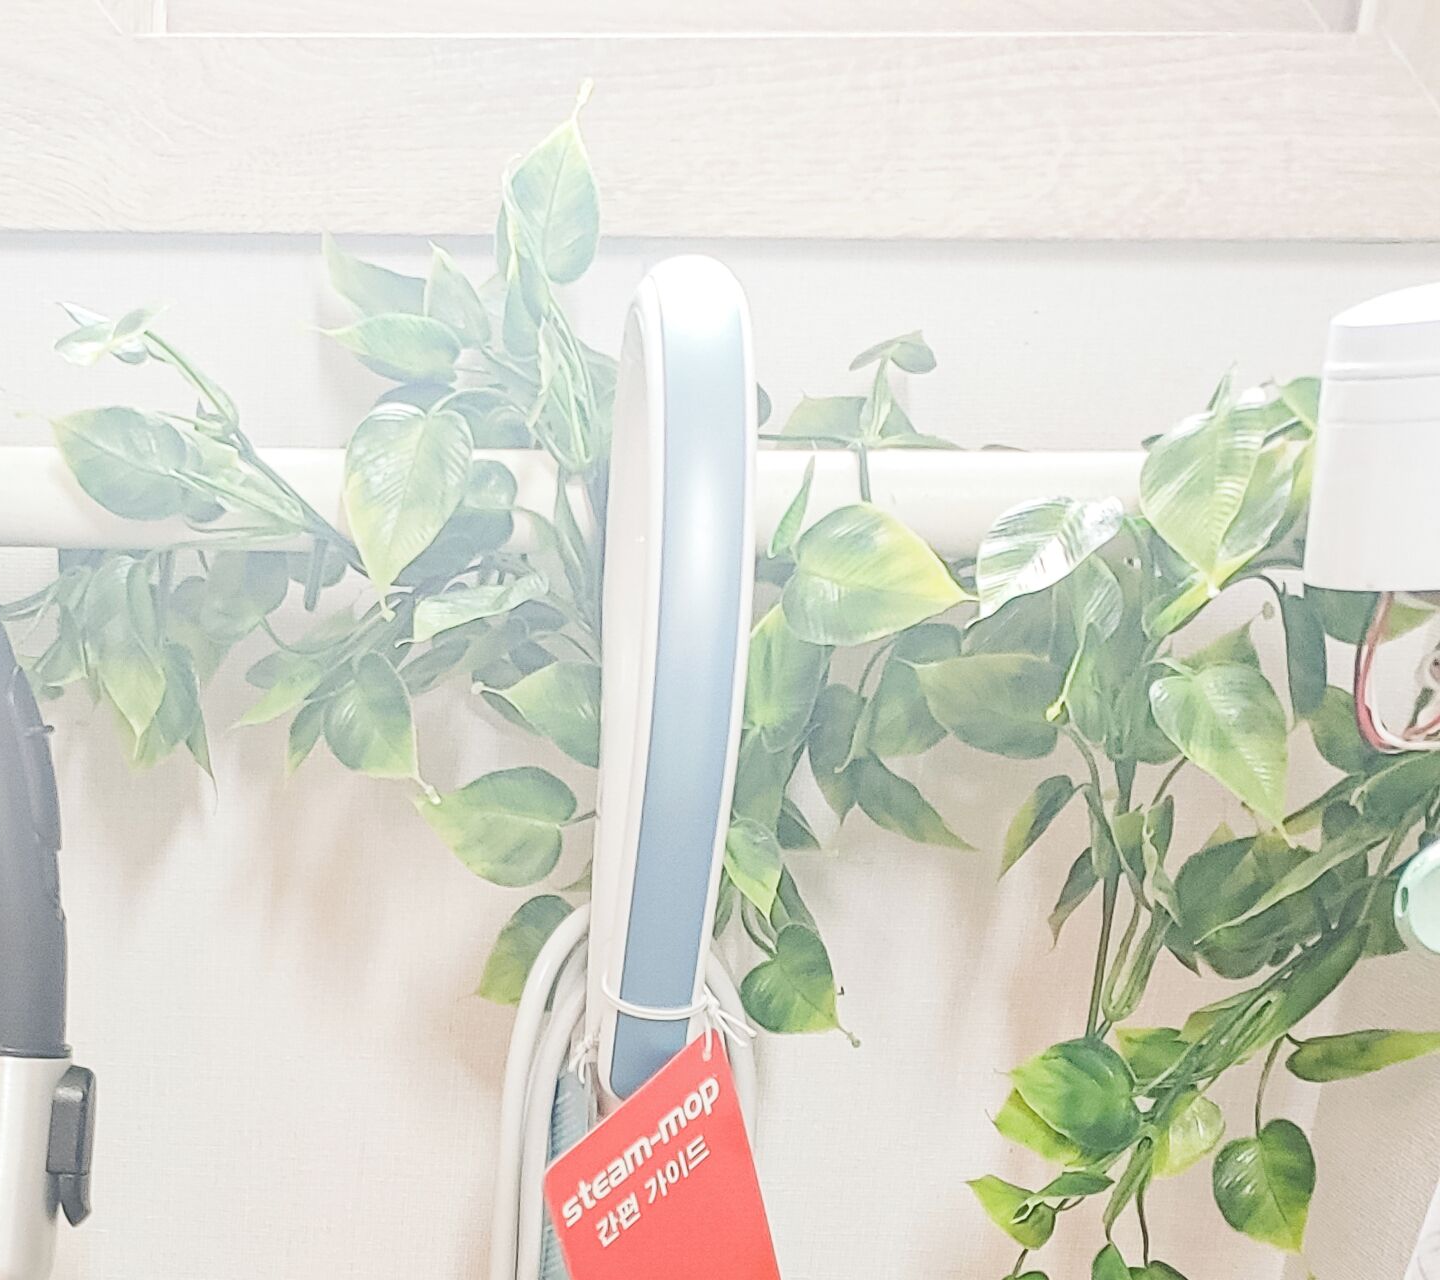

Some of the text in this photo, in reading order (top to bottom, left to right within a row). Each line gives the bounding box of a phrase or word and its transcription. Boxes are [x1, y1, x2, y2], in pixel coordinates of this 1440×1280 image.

[562, 1077, 720, 1228] steam-mop
[595, 1135, 711, 1248] 간편 가이드
